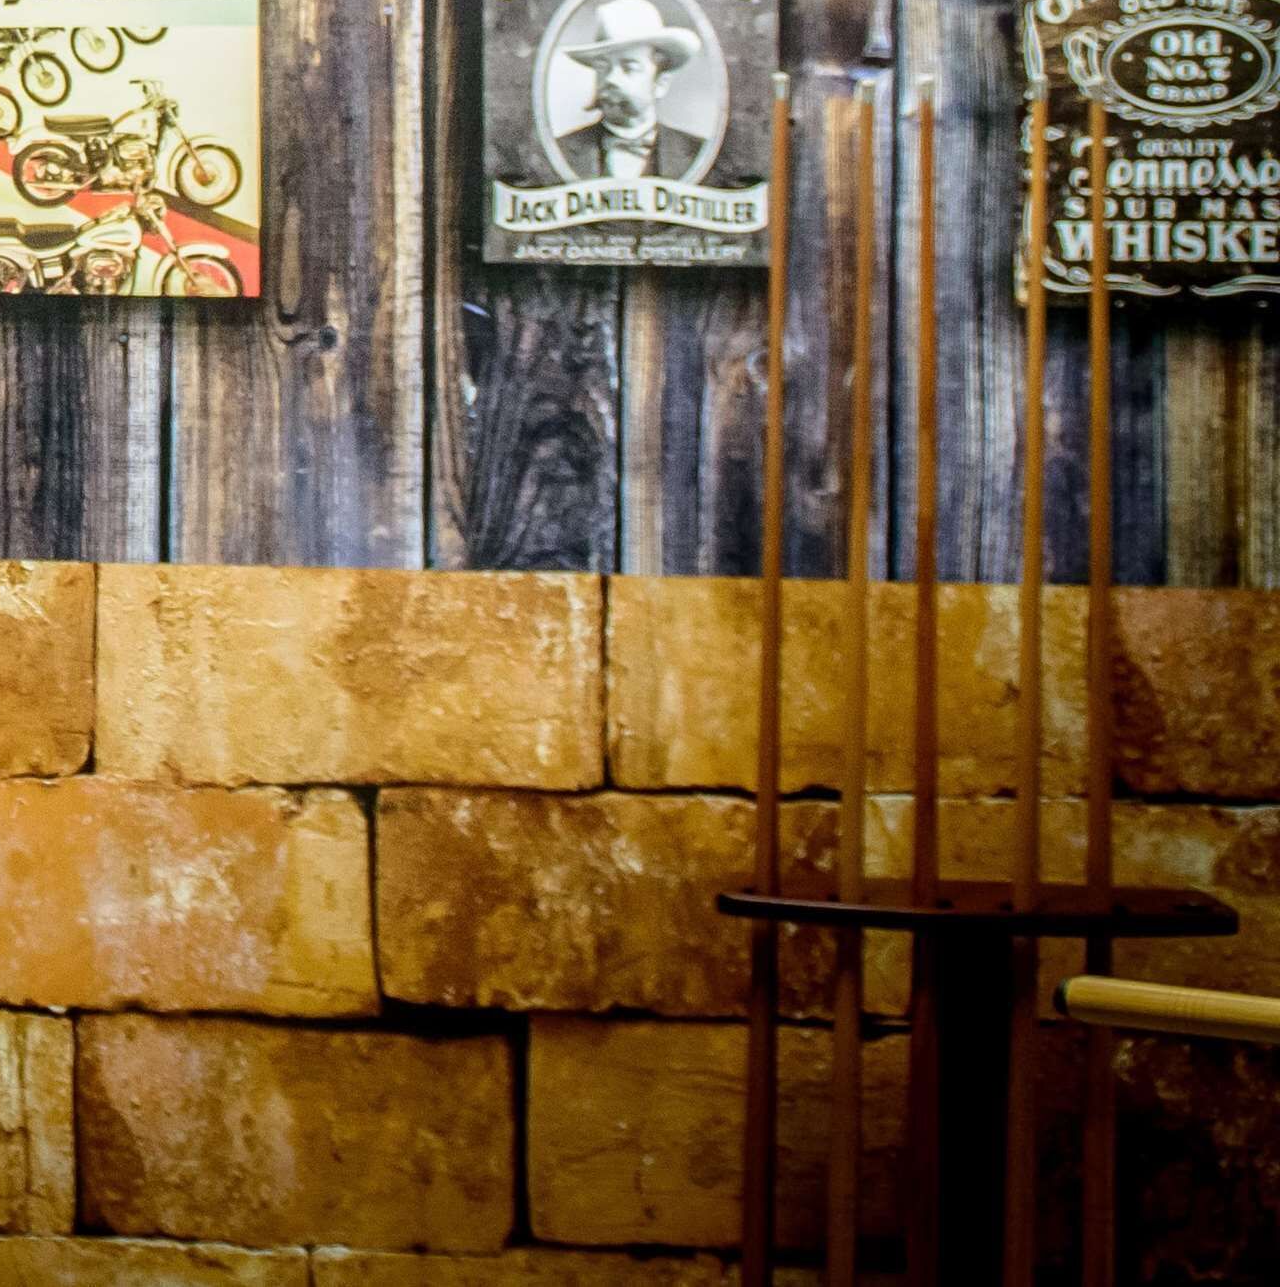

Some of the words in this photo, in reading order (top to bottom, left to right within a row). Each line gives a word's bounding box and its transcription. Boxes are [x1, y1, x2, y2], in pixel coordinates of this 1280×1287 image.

[1137, 138, 1234, 157] QUALITY
[506, 194, 558, 223] JACK
[567, 188, 644, 217] DANIEL
[514, 245, 565, 260] JACK
